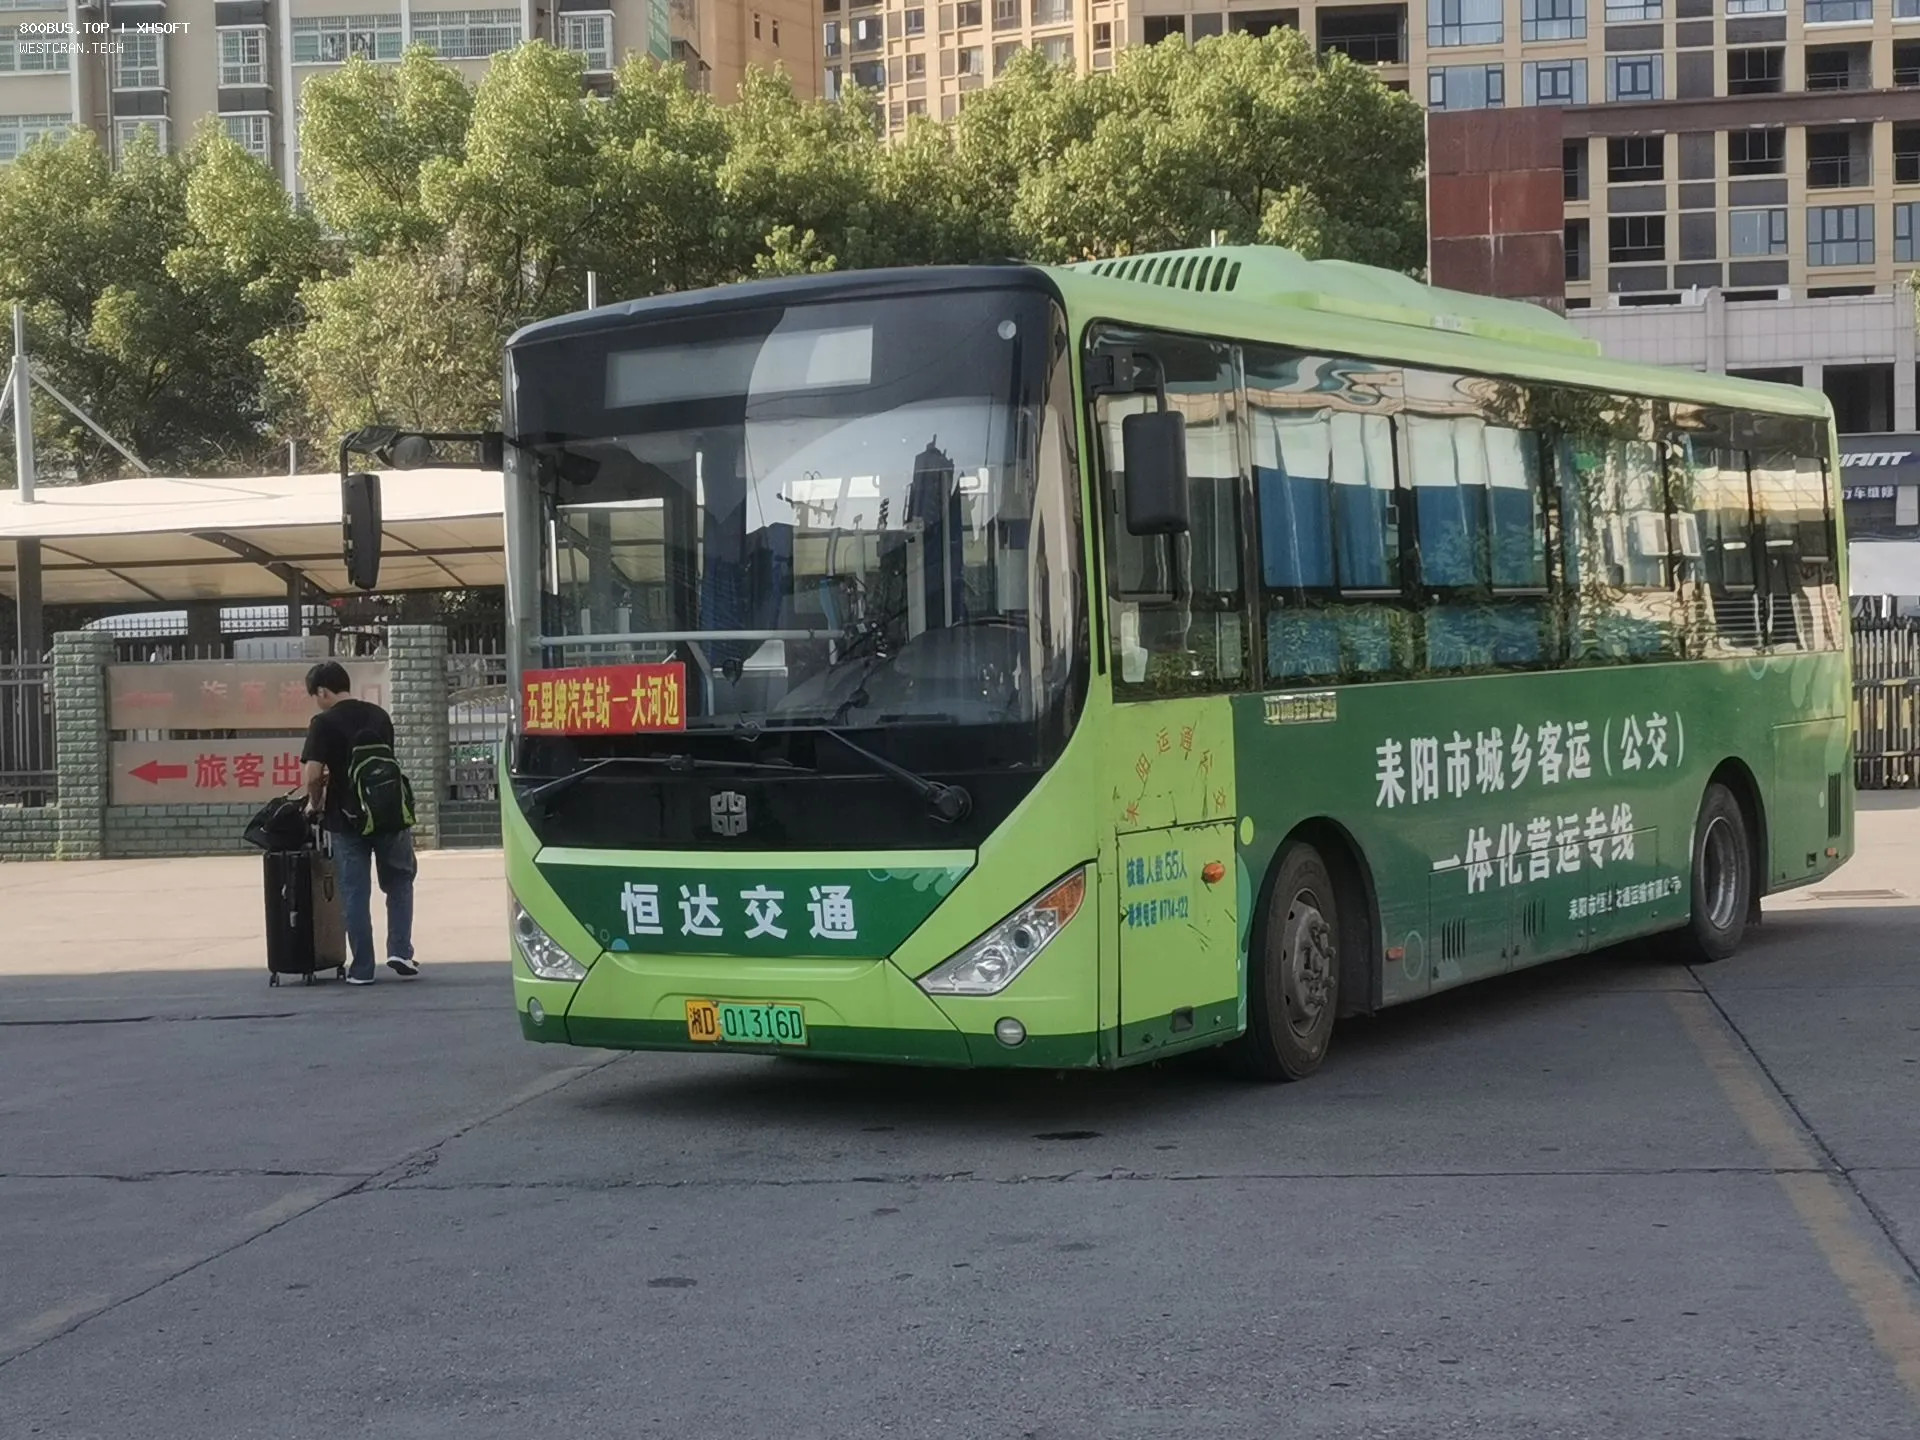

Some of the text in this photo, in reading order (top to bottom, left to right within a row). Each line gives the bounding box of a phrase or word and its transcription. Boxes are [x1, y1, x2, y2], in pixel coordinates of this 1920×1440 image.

[1839, 451, 1912, 467] IANT
[195, 752, 328, 789] 旅客出
[1432, 802, 1635, 894] 一体化营运专线
[620, 881, 858, 940] 恒达交通
